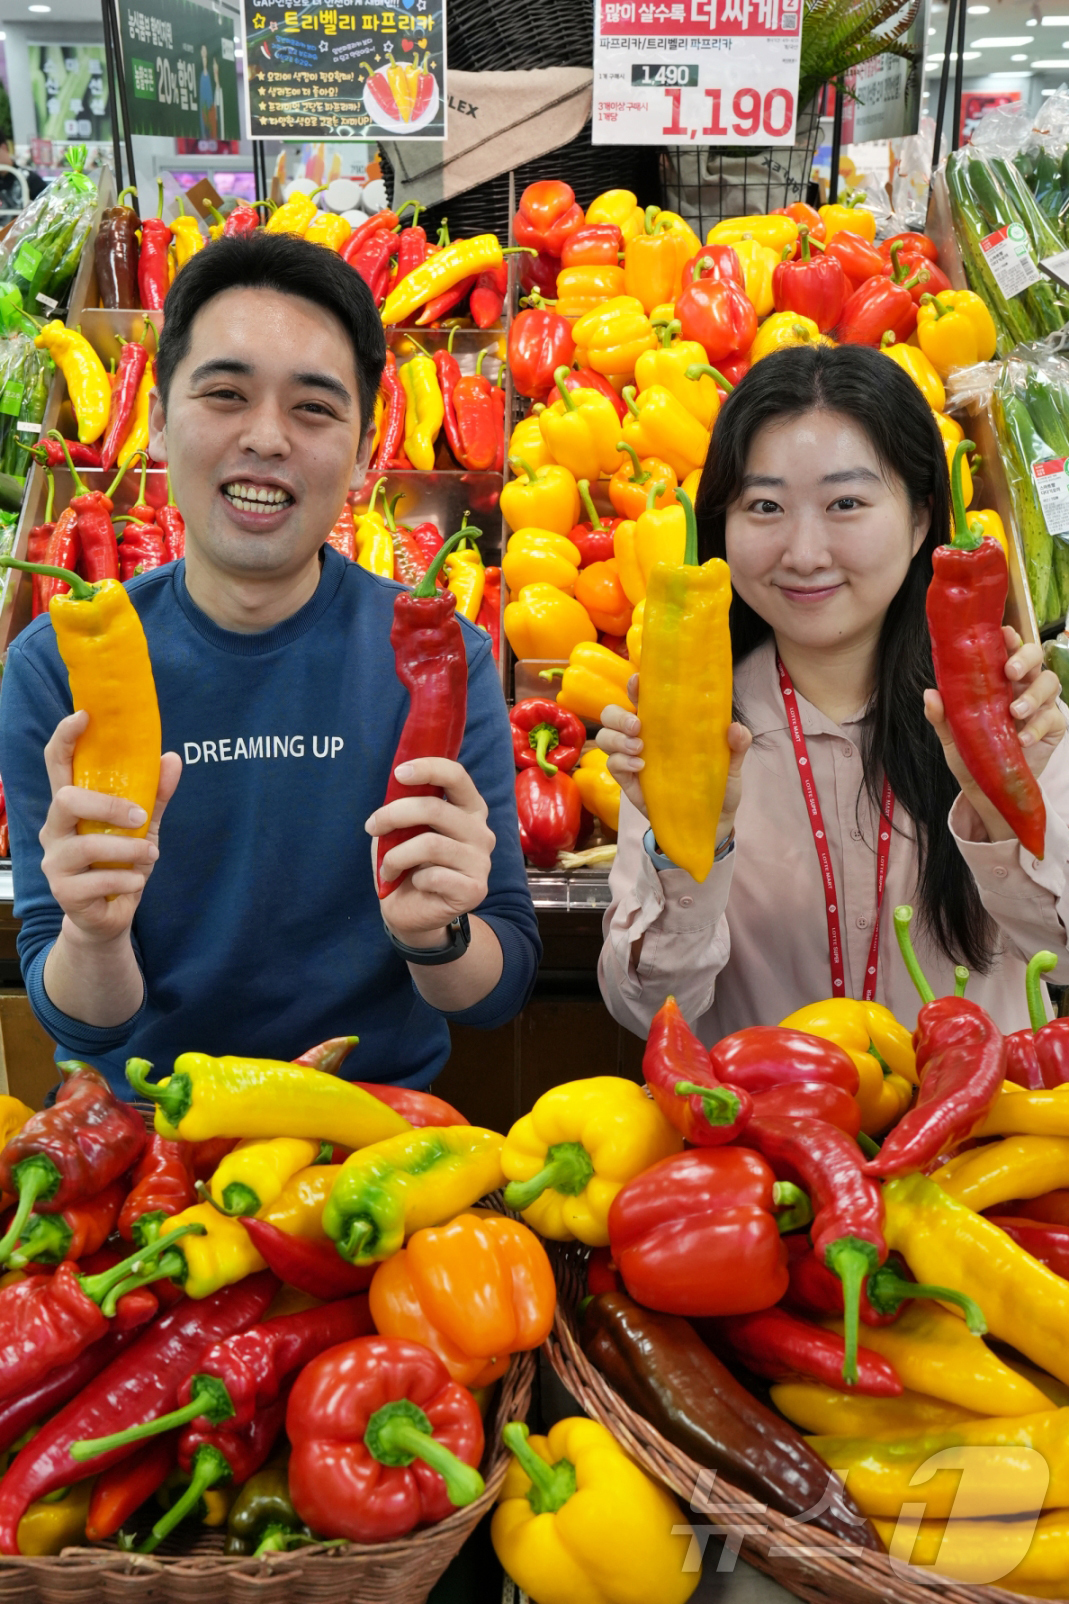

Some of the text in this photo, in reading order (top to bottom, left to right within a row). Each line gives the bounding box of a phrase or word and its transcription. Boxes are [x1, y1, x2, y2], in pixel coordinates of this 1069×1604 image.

[128, 8, 152, 43] 농식품부
[284, 10, 435, 35] 트리벨리 파프리카
[605, 0, 779, 30] 많이 살수록 더 싸게
[600, 38, 733, 50] 파프리카/트리벨리 파프리카
[642, 66, 690, 85] 1,490
[447, 94, 479, 119] LEX
[598, 102, 648, 112] 3개이상 구매시
[598, 112, 618, 122] 1개당
[663, 88, 794, 140] 1,190
[789, 707, 802, 743] LOTTE MART
[183, 735, 344, 764] DREAMING UP
[805, 779, 818, 816] LOTTE SUPER
[821, 853, 829, 872] LOTTE
